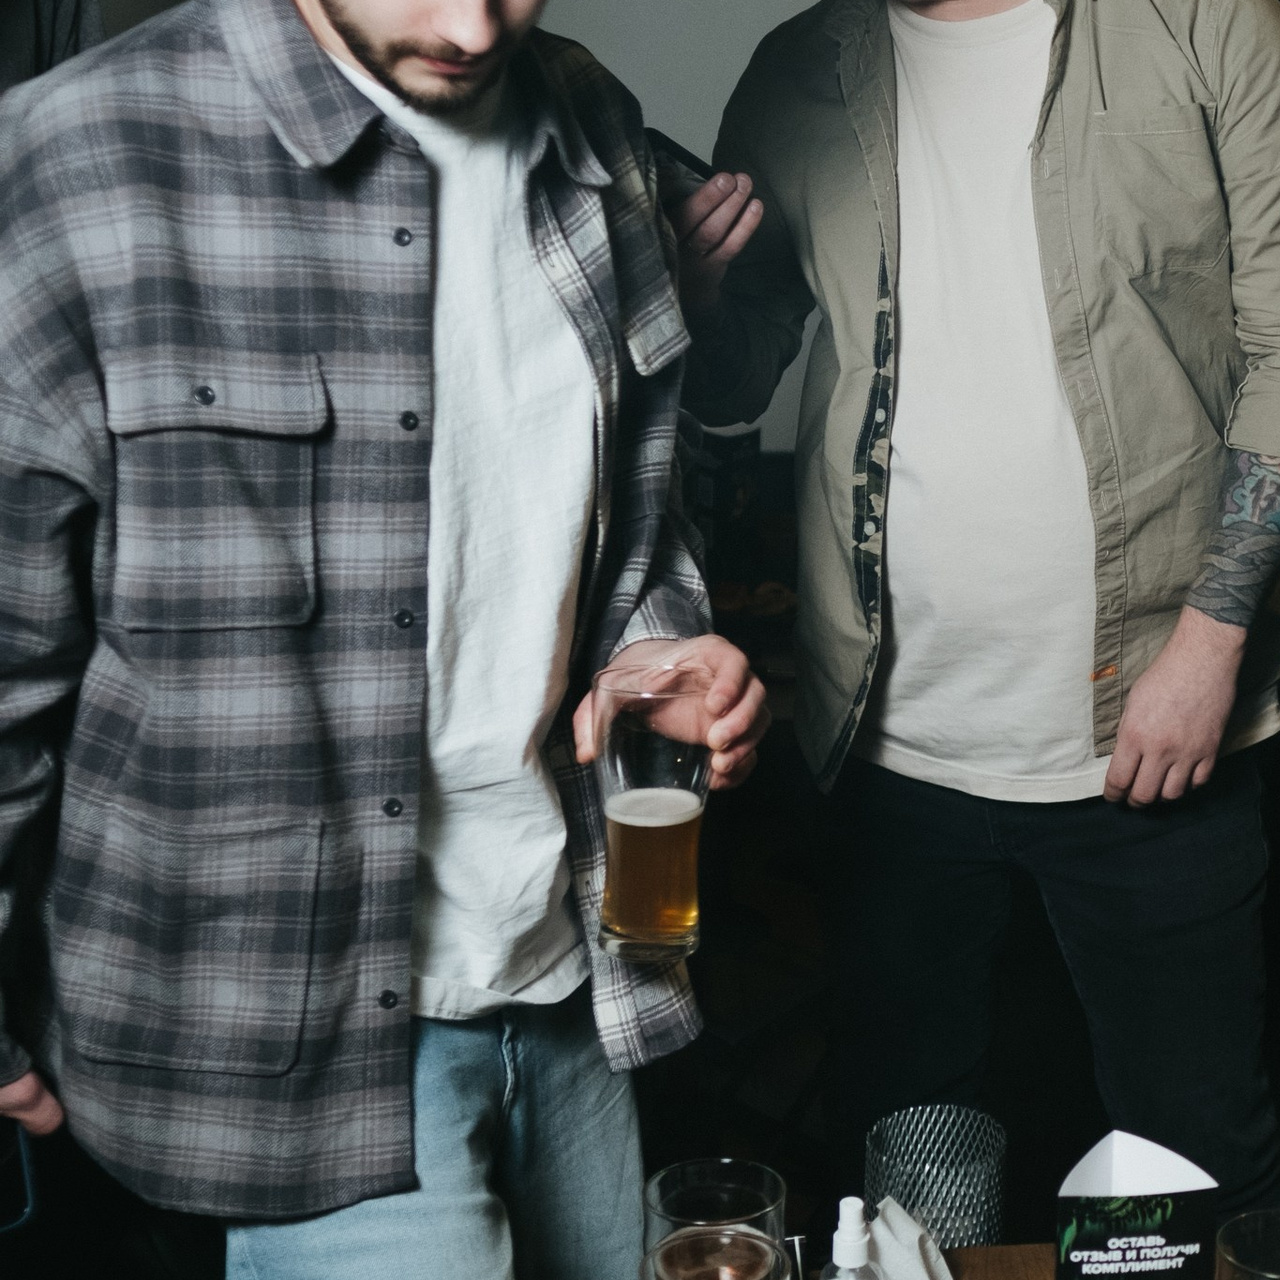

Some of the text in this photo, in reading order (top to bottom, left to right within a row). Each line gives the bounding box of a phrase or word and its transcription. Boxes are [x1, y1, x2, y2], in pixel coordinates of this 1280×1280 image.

[1107, 1235, 1166, 1249] ОСТАВЬ
[1070, 1243, 1200, 1263] ОТЗЫВ И ПОЛУЧИ
[1082, 1257, 1185, 1275] КОМПЛИМЕНТ
